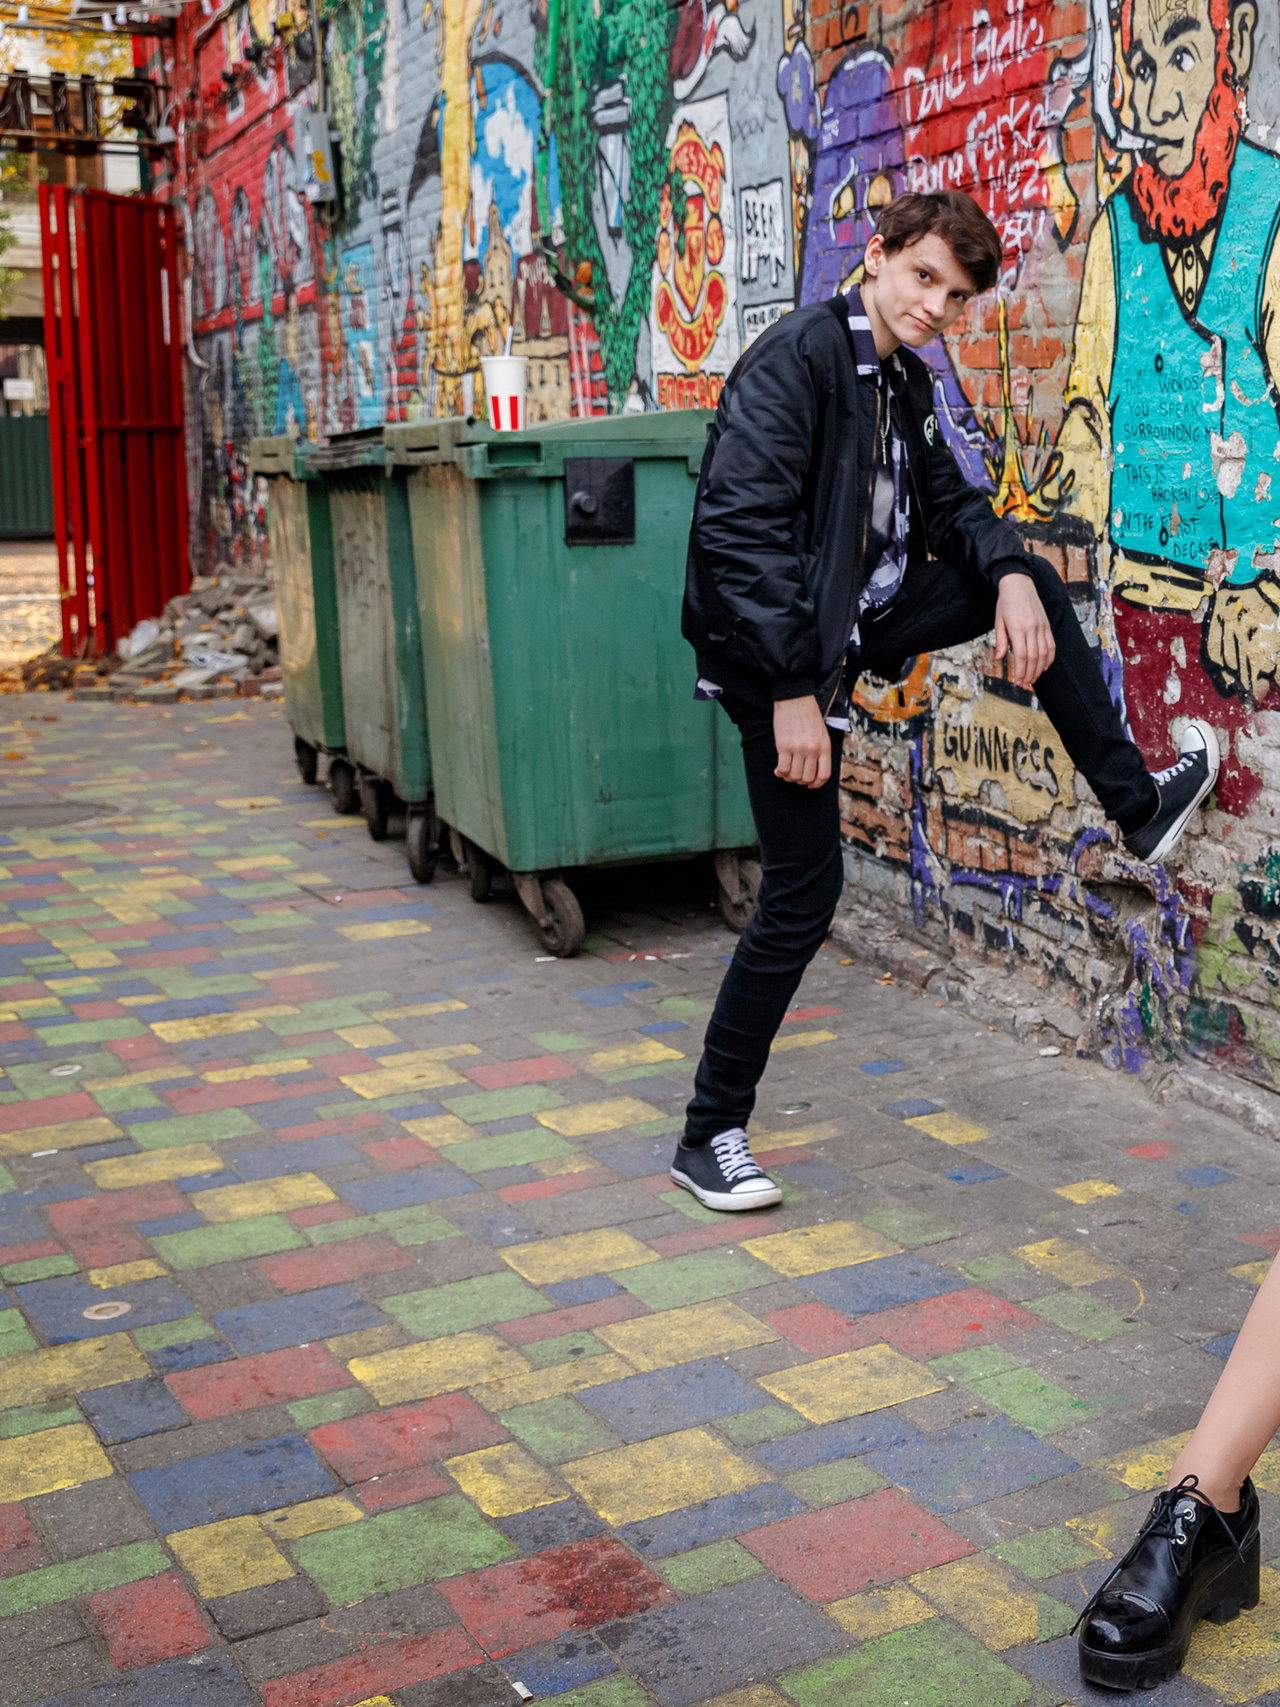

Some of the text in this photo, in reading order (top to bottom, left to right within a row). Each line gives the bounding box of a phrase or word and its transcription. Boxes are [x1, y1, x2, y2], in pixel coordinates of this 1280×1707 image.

[1125, 378, 1142, 395] THE
[1128, 401, 1200, 418] YOU SPEAK
[1124, 423, 1200, 442] SURROUNDING
[1123, 463, 1167, 486] THIS IS
[1151, 486, 1191, 504] BROKEN
